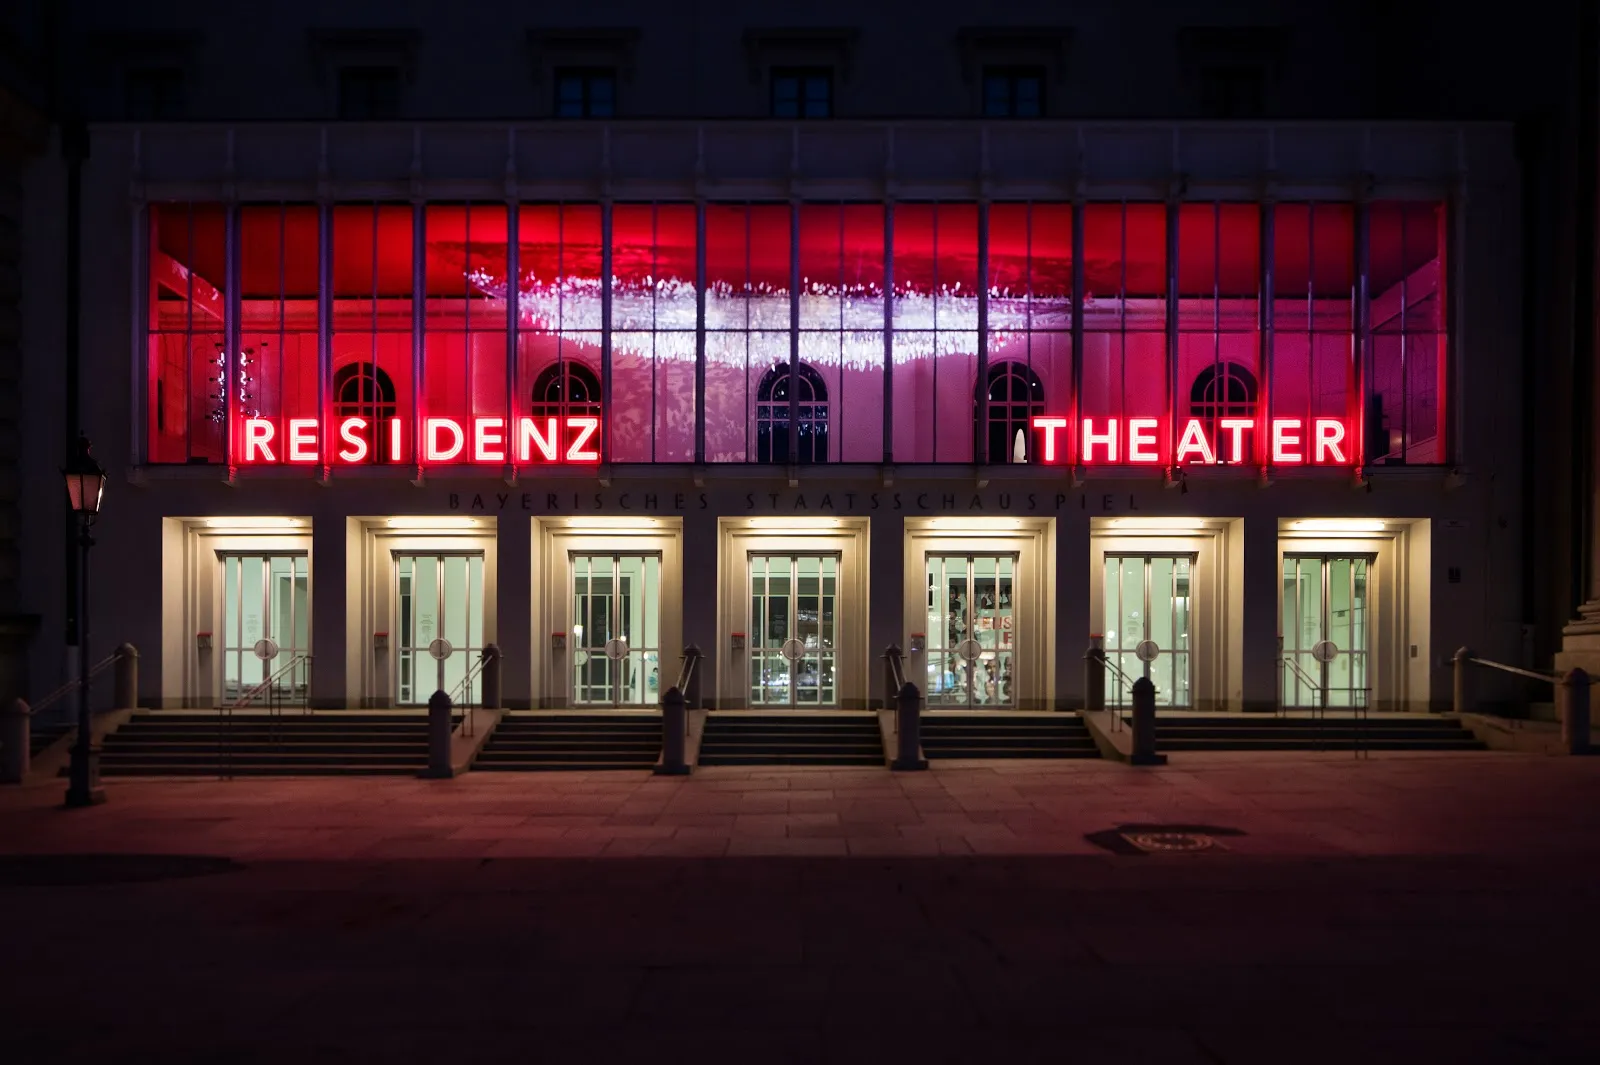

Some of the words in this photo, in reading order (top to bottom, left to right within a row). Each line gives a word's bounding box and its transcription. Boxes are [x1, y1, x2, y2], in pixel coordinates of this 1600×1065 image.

[245, 418, 599, 463] RESIDENZ
[1033, 418, 1345, 463] THEATER
[449, 493, 708, 510] BAYERISCHES
[746, 493, 1138, 511] STAATSSCHAUSPIEL
